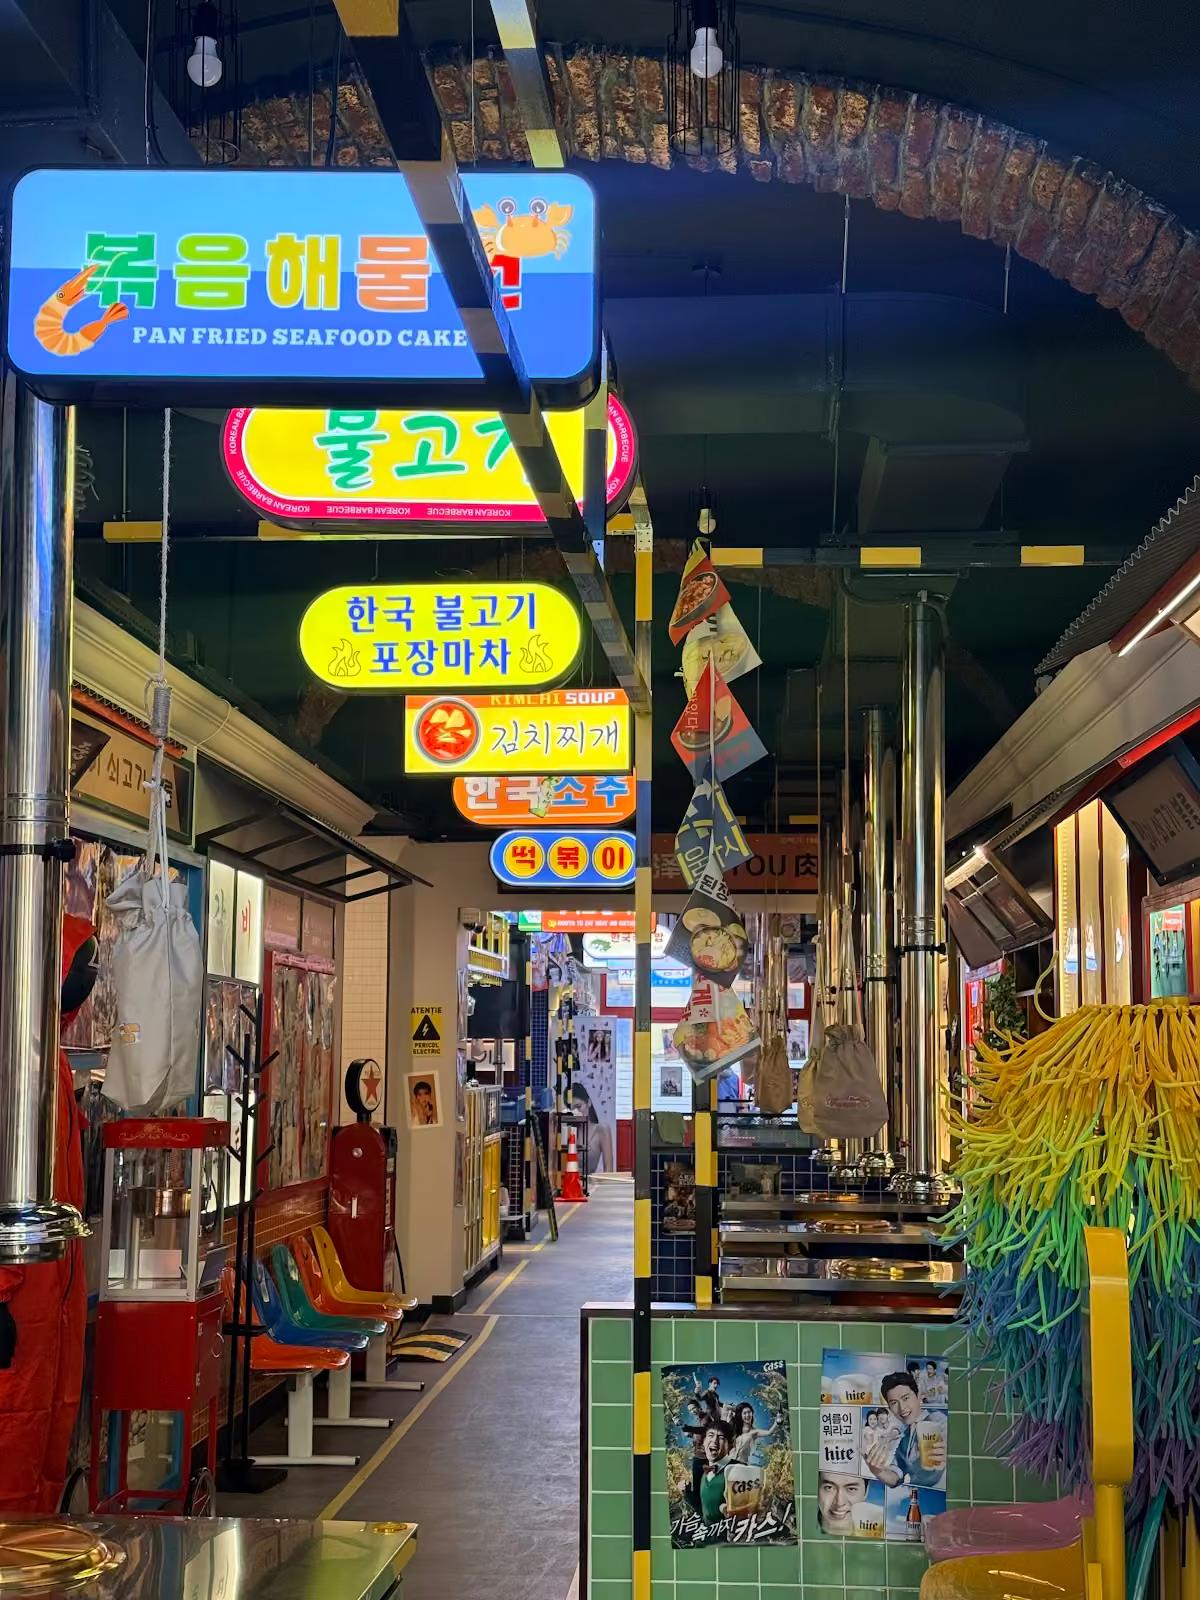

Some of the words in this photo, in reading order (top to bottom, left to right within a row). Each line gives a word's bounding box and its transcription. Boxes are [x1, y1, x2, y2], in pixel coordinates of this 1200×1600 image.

[133, 327, 186, 344] PAN
[191, 327, 268, 345] FRIED
[272, 328, 393, 346] SEAFOOD
[397, 330, 468, 348] CAKE
[229, 417, 241, 455] KOREAN
[615, 416, 629, 463] BARBECUE
[236, 470, 273, 506] BARBECUE
[273, 500, 311, 513] KOREAN
[326, 505, 373, 514] BARBECUE
[374, 506, 411, 515] KOREAN
[426, 507, 475, 516] BARBECUE
[475, 508, 512, 517] KOREAN
[346, 595, 416, 633] 한국
[432, 593, 537, 632] 불고기
[368, 638, 512, 677] 포장마차
[565, 691, 616, 705] SOUP
[491, 720, 619, 755] 김치찌개
[511, 845, 625, 870] 떡볶이
[845, 1389, 866, 1401] hite
[821, 1412, 852, 1425] 여름이
[823, 1425, 853, 1437] 뭐라고
[922, 1433, 937, 1441] hite
[825, 1446, 854, 1461] hite
[859, 1519, 879, 1531] hite
